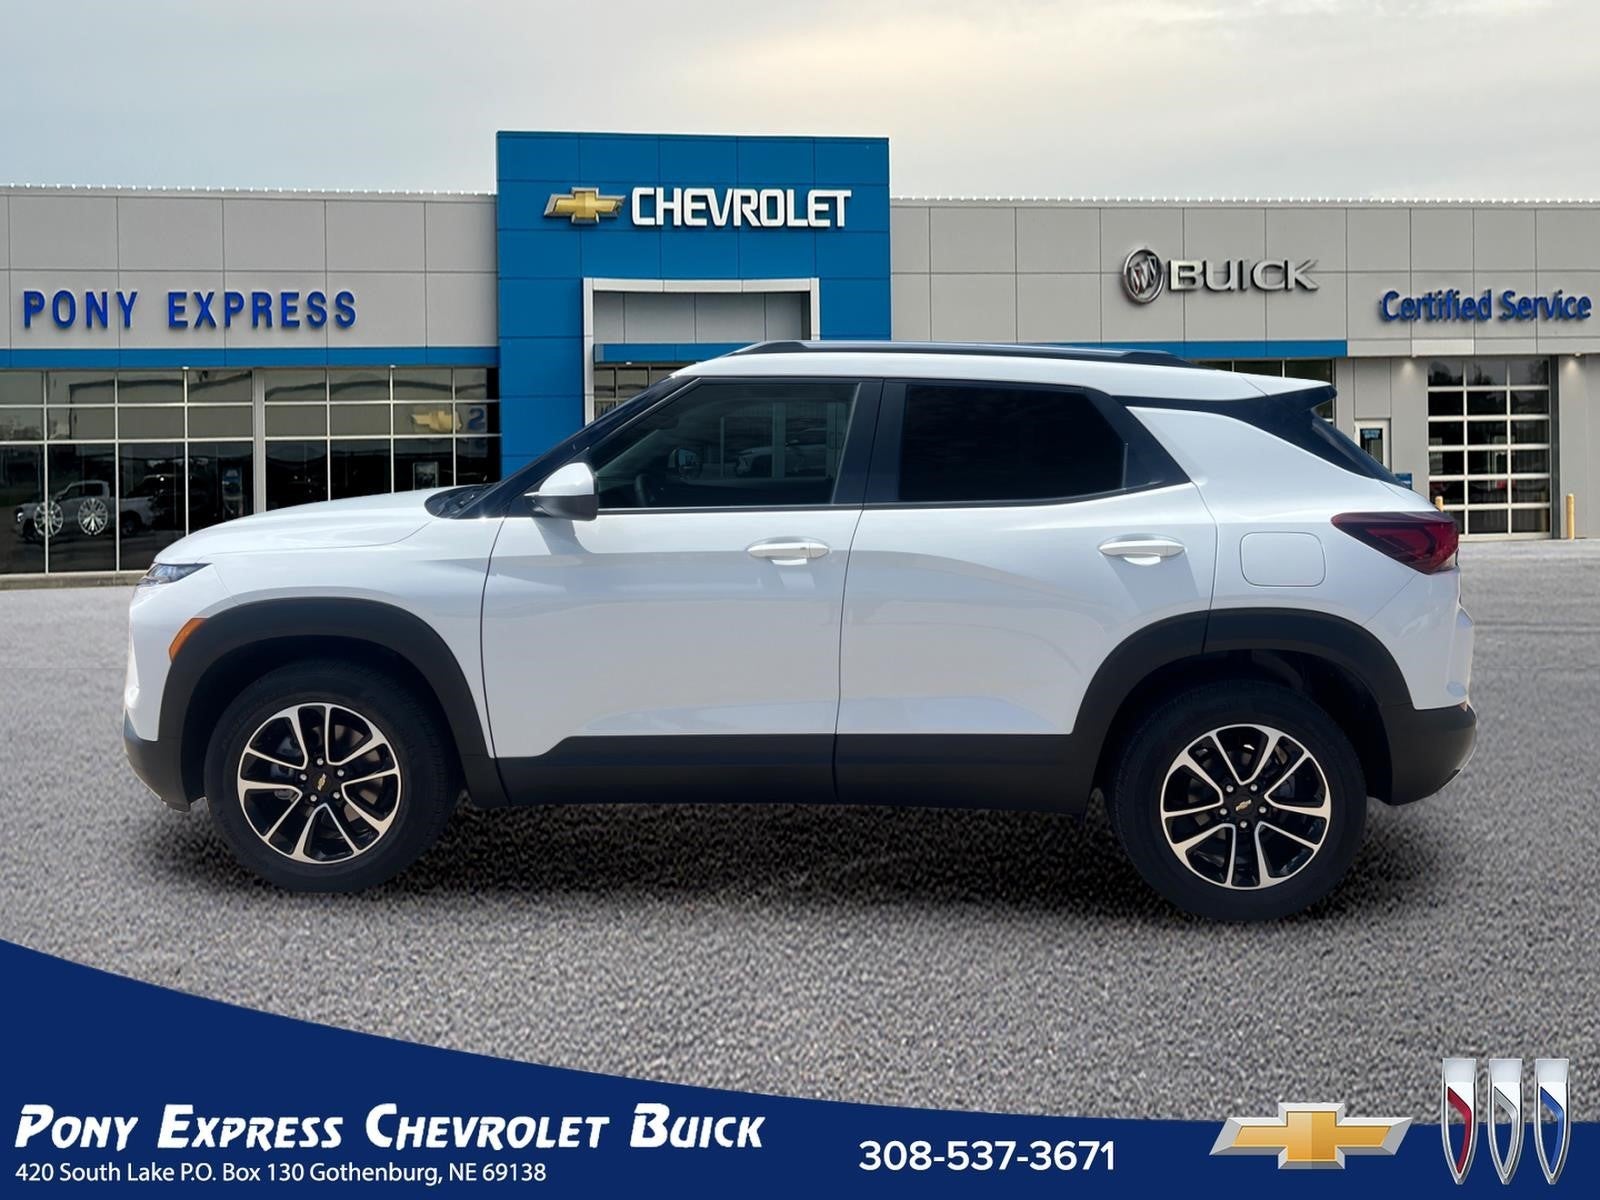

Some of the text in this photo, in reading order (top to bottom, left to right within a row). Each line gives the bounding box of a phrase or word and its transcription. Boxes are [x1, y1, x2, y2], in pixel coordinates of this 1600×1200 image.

[631, 187, 852, 227] CHEVROLET
[1169, 258, 1319, 291] BUICK
[23, 290, 358, 329] PONY EXPRESS
[1381, 288, 1592, 321] Certified Service
